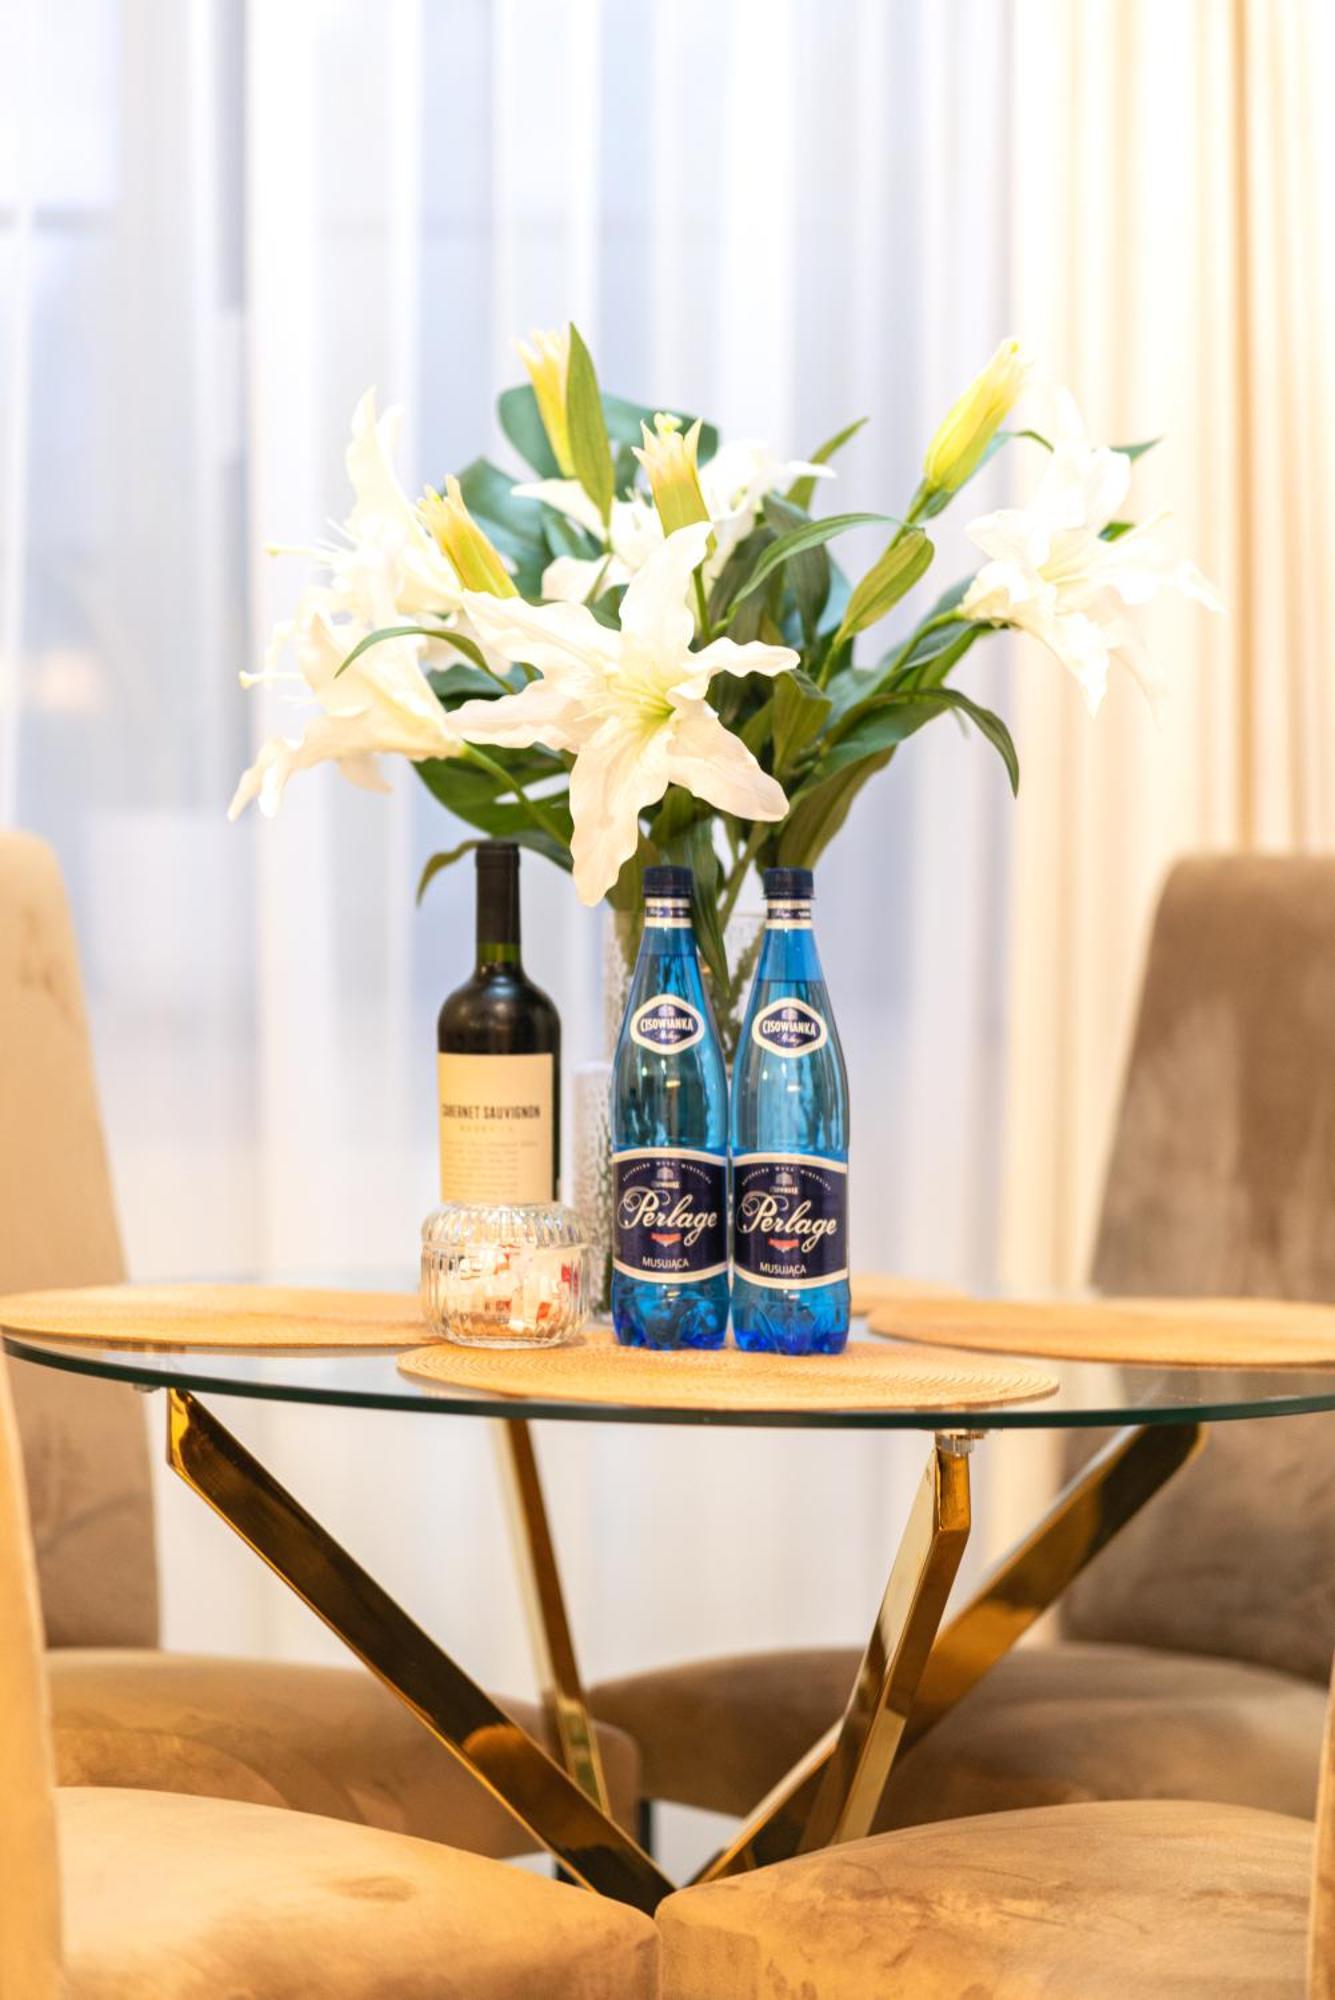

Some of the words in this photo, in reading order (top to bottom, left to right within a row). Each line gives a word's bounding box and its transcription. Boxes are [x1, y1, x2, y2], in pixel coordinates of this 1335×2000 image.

[640, 1017, 694, 1032] CISOWIANKA
[762, 1020, 817, 1037] CISOWIANKA
[484, 1105, 541, 1120] SAUVIGNON
[617, 1186, 718, 1247] Perlage
[736, 1190, 838, 1253] Perlage
[642, 1256, 689, 1270] MUSUJĄCA
[759, 1261, 807, 1276] MUSUJĄCA
